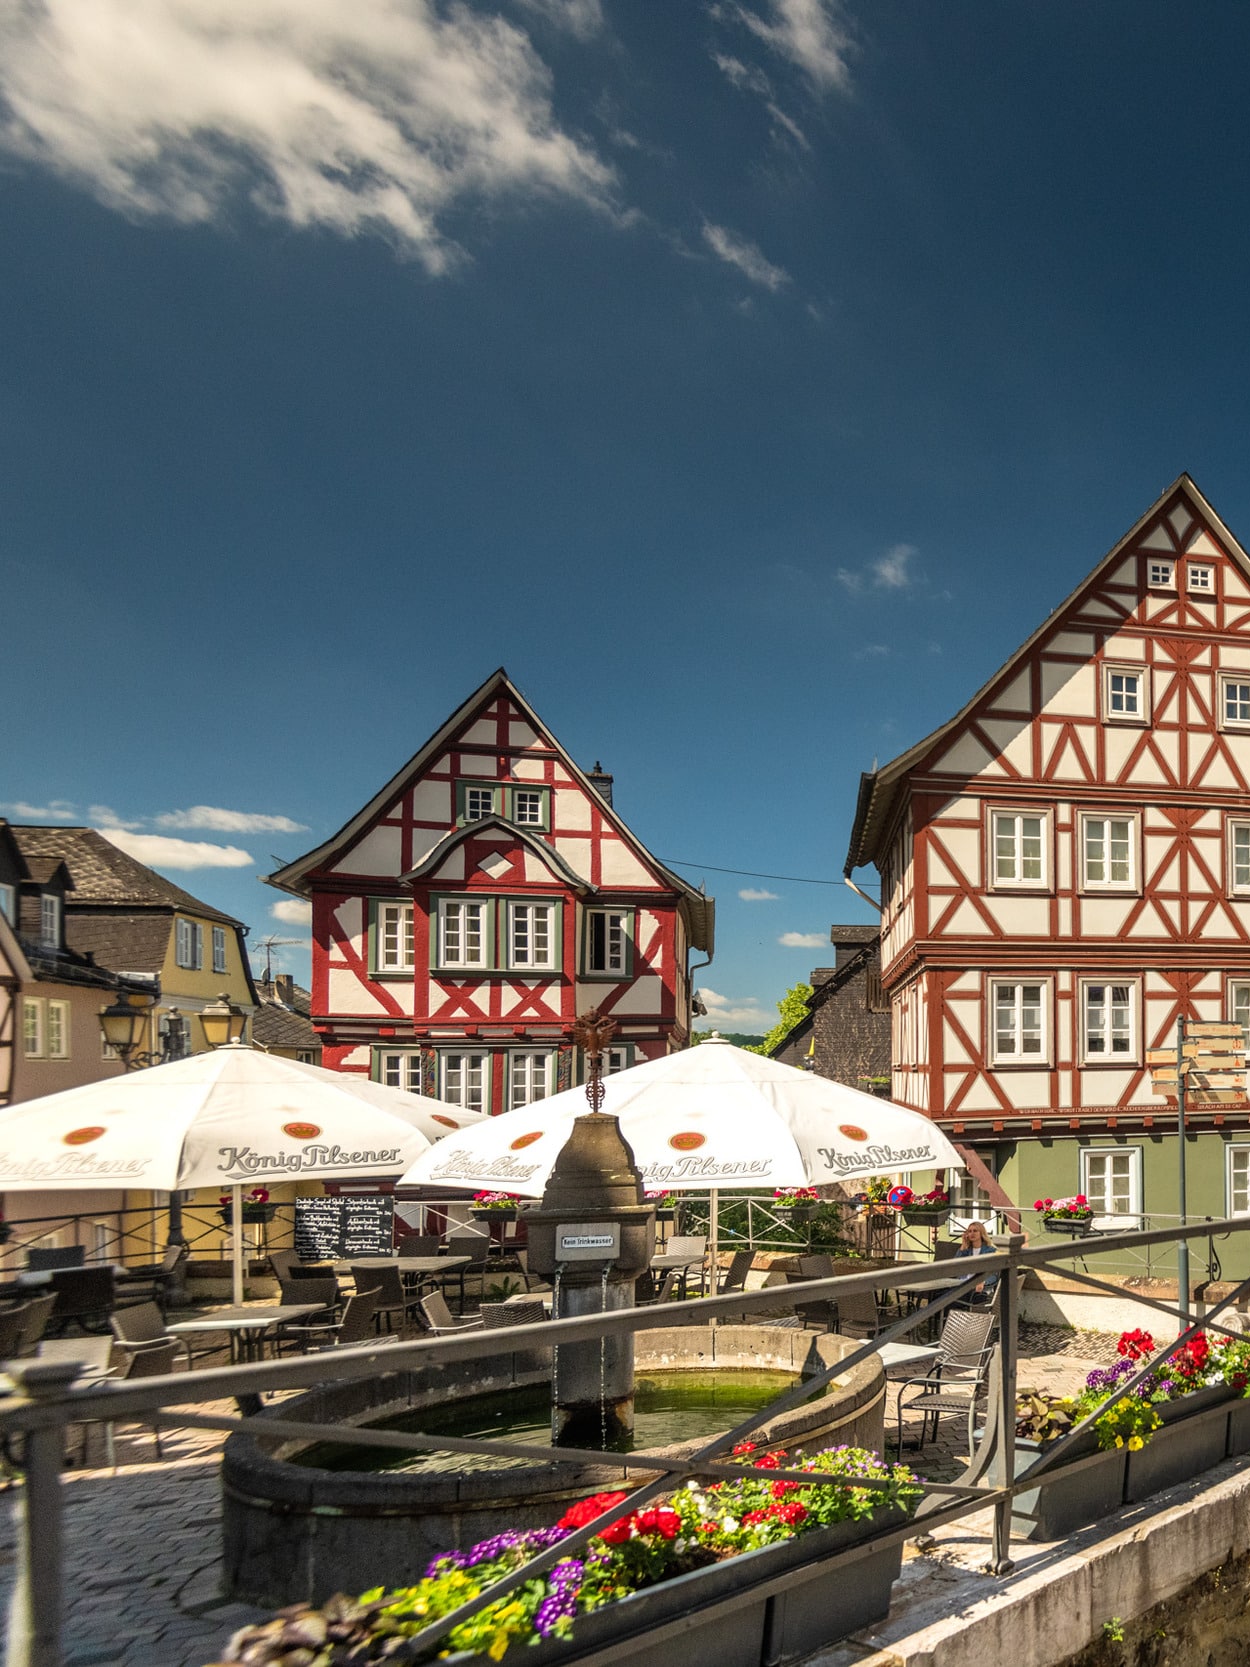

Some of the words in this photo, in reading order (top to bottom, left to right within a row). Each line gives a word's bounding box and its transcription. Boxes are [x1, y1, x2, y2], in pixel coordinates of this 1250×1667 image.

[48, 1151, 151, 1176] Pilsener
[217, 1146, 301, 1174] König
[301, 1144, 401, 1167] Pilsener
[480, 1155, 542, 1178] Pilsener
[638, 1161, 674, 1182] nig
[670, 1156, 773, 1177] Pilsener
[817, 1148, 876, 1170] König
[866, 1144, 931, 1164] Pilsener
